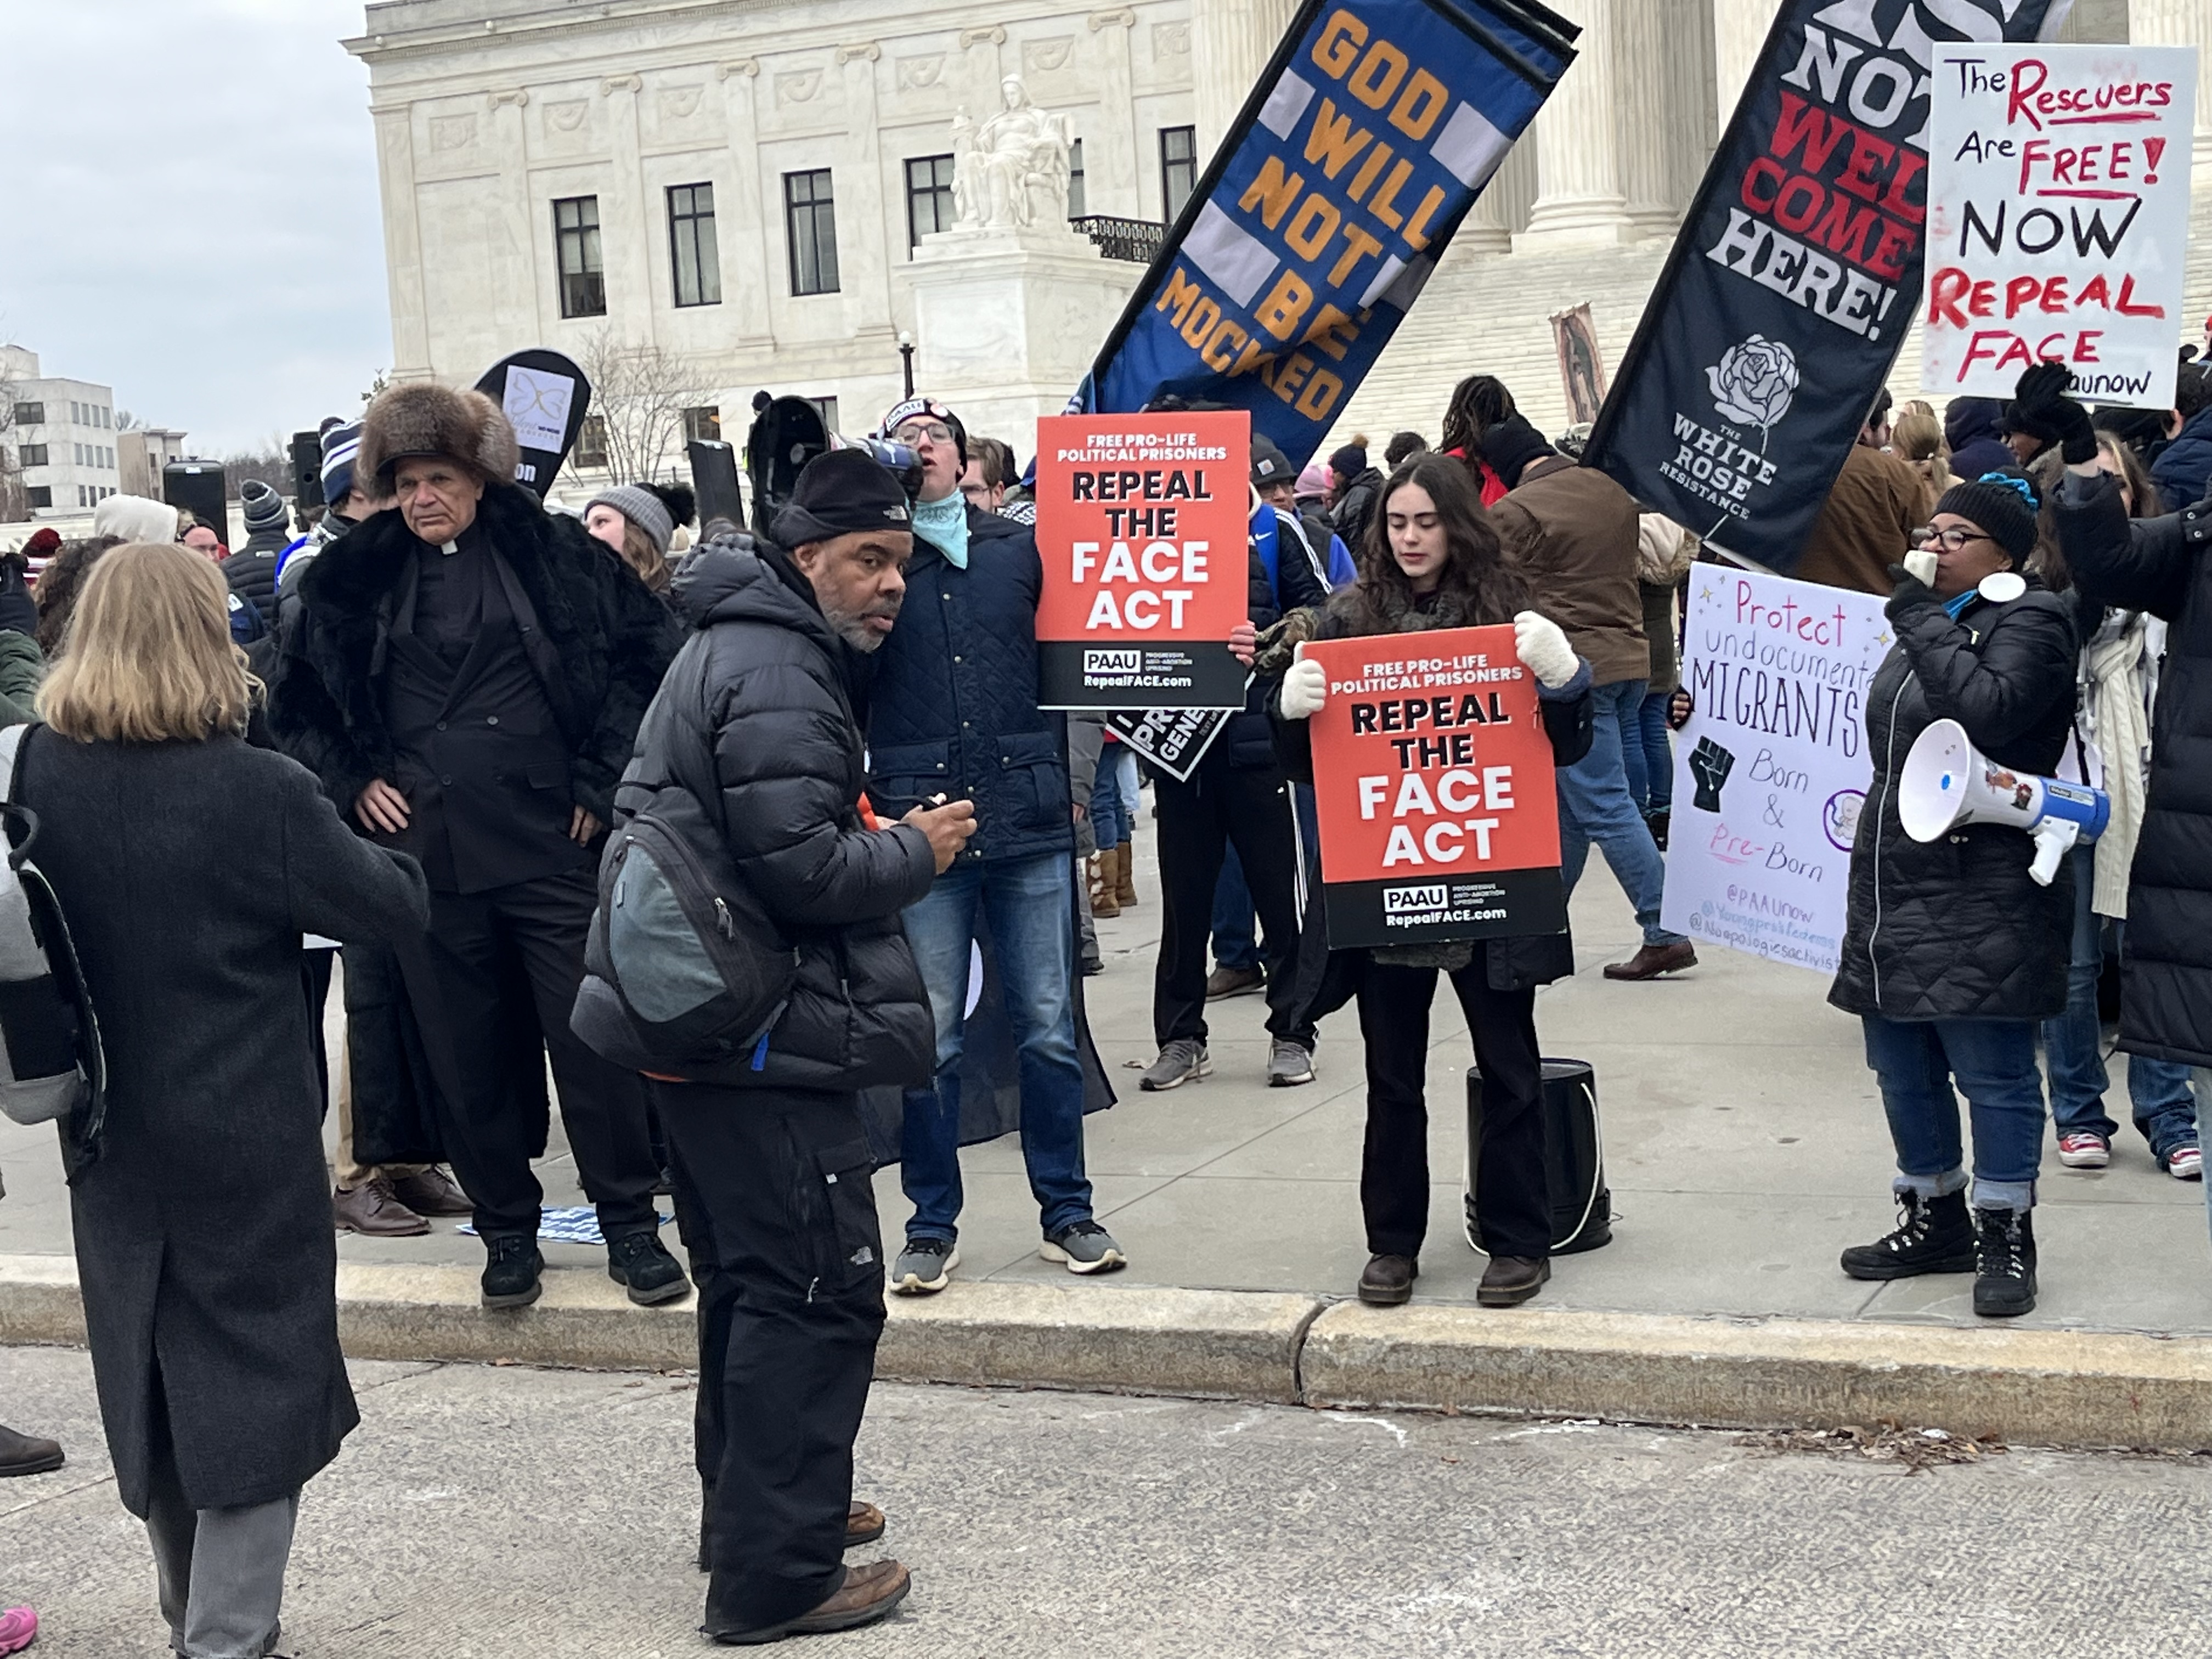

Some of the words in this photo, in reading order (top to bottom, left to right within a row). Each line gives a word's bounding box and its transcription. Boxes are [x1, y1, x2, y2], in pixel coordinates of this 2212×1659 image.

[1312, 9, 1449, 140] GOD
[1944, 59, 2006, 99] The
[2008, 59, 2172, 131] Rescuers
[1304, 98, 1446, 251] WILL
[1770, 90, 1928, 225] WEL
[1955, 131, 2016, 163] Are
[2019, 137, 2166, 195] FREE!
[1238, 155, 1384, 289] NOT
[1741, 156, 1916, 281] COME
[1960, 198, 2142, 259] NOW
[1706, 207, 1897, 341] HERE!
[1927, 267, 2165, 329] REPEAL
[1254, 269, 1372, 362] BE
[1956, 330, 2104, 383] FACE
[2067, 371, 2152, 395] aunow
[1058, 449, 1137, 462] POLITICAL
[1139, 447, 1227, 460] PRISONERS
[1086, 435, 1122, 448] FREE
[1125, 433, 1197, 447] PRO-LIFE
[1674, 412, 1778, 486] WHITE
[1720, 424, 1742, 441] THE
[1073, 470, 1213, 503] REPEAL
[1659, 461, 1751, 520] RESISTANCE
[1674, 444, 1752, 501] ROSE
[1105, 508, 1177, 540] THE
[1072, 541, 1209, 583] FACE
[1085, 590, 1193, 630] ACT
[1737, 580, 1846, 647] Protect
[1084, 675, 1192, 690] RepealFACE.com
[1088, 653, 1137, 669] PAAU
[1331, 676, 1421, 695] POLITICAL
[1424, 666, 1522, 688] PRISONERS
[1363, 661, 1403, 678] FREE
[1407, 654, 1487, 673] PRO-LIFE
[1705, 628, 1876, 691] undocumente
[1131, 709, 1177, 752] PR
[1351, 692, 1511, 737] REPEAL
[1692, 657, 1858, 758] MIGRANTS
[1159, 709, 1207, 761] GENE
[1390, 733, 1475, 771] THE
[1358, 765, 1514, 820] FACE
[1749, 748, 1809, 794] Born
[1763, 794, 1784, 828] &
[1382, 818, 1499, 867] ACT
[1386, 909, 1507, 928] RepealFACE.com
[1388, 889, 1443, 908] PAAU
